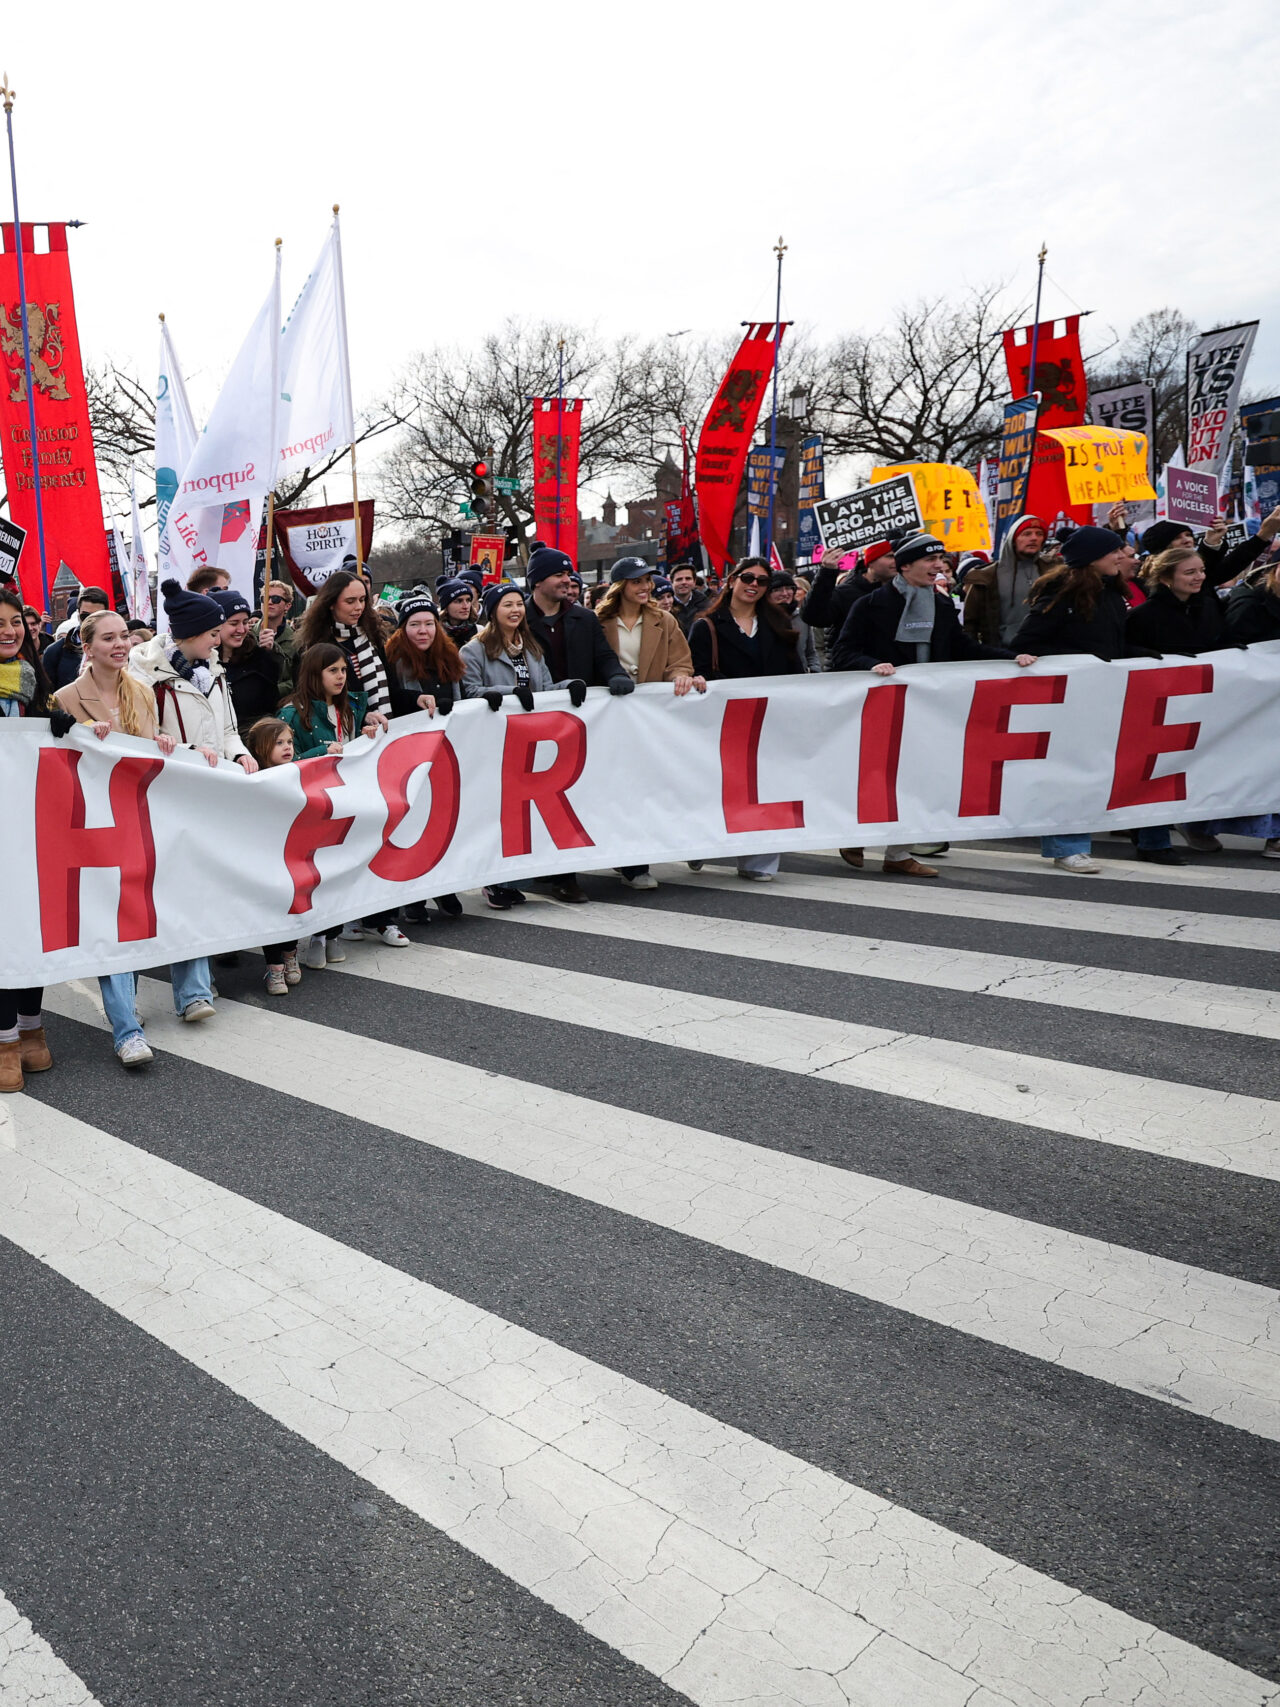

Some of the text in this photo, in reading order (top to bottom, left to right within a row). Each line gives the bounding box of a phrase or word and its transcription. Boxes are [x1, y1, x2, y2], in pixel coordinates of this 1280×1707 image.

[1194, 343, 1245, 370] LIFE
[1192, 362, 1237, 400] IS
[1098, 395, 1145, 416] LIFE
[1100, 408, 1147, 433] IS
[1190, 410, 1227, 432] RVO
[9, 424, 79, 444] Trdition
[21, 447, 72, 467] Fmily
[1067, 443, 1089, 467] IS
[1092, 440, 1124, 460] TRUE
[1188, 443, 1221, 466] ON!
[1176, 480, 1209, 495] A VOICE
[1182, 491, 1192, 499] FOR
[823, 511, 829, 522] I
[838, 500, 865, 517] AM
[871, 486, 907, 505] THE
[1171, 497, 1215, 515] VOICELESS
[822, 496, 915, 537] PRO-LIFE
[174, 511, 199, 549] Life
[307, 526, 342, 540] HOLY
[827, 511, 917, 549] GENERATION
[305, 537, 346, 552] SPIRIT
[284, 710, 596, 915] FOR
[721, 664, 1214, 834] LIFE
